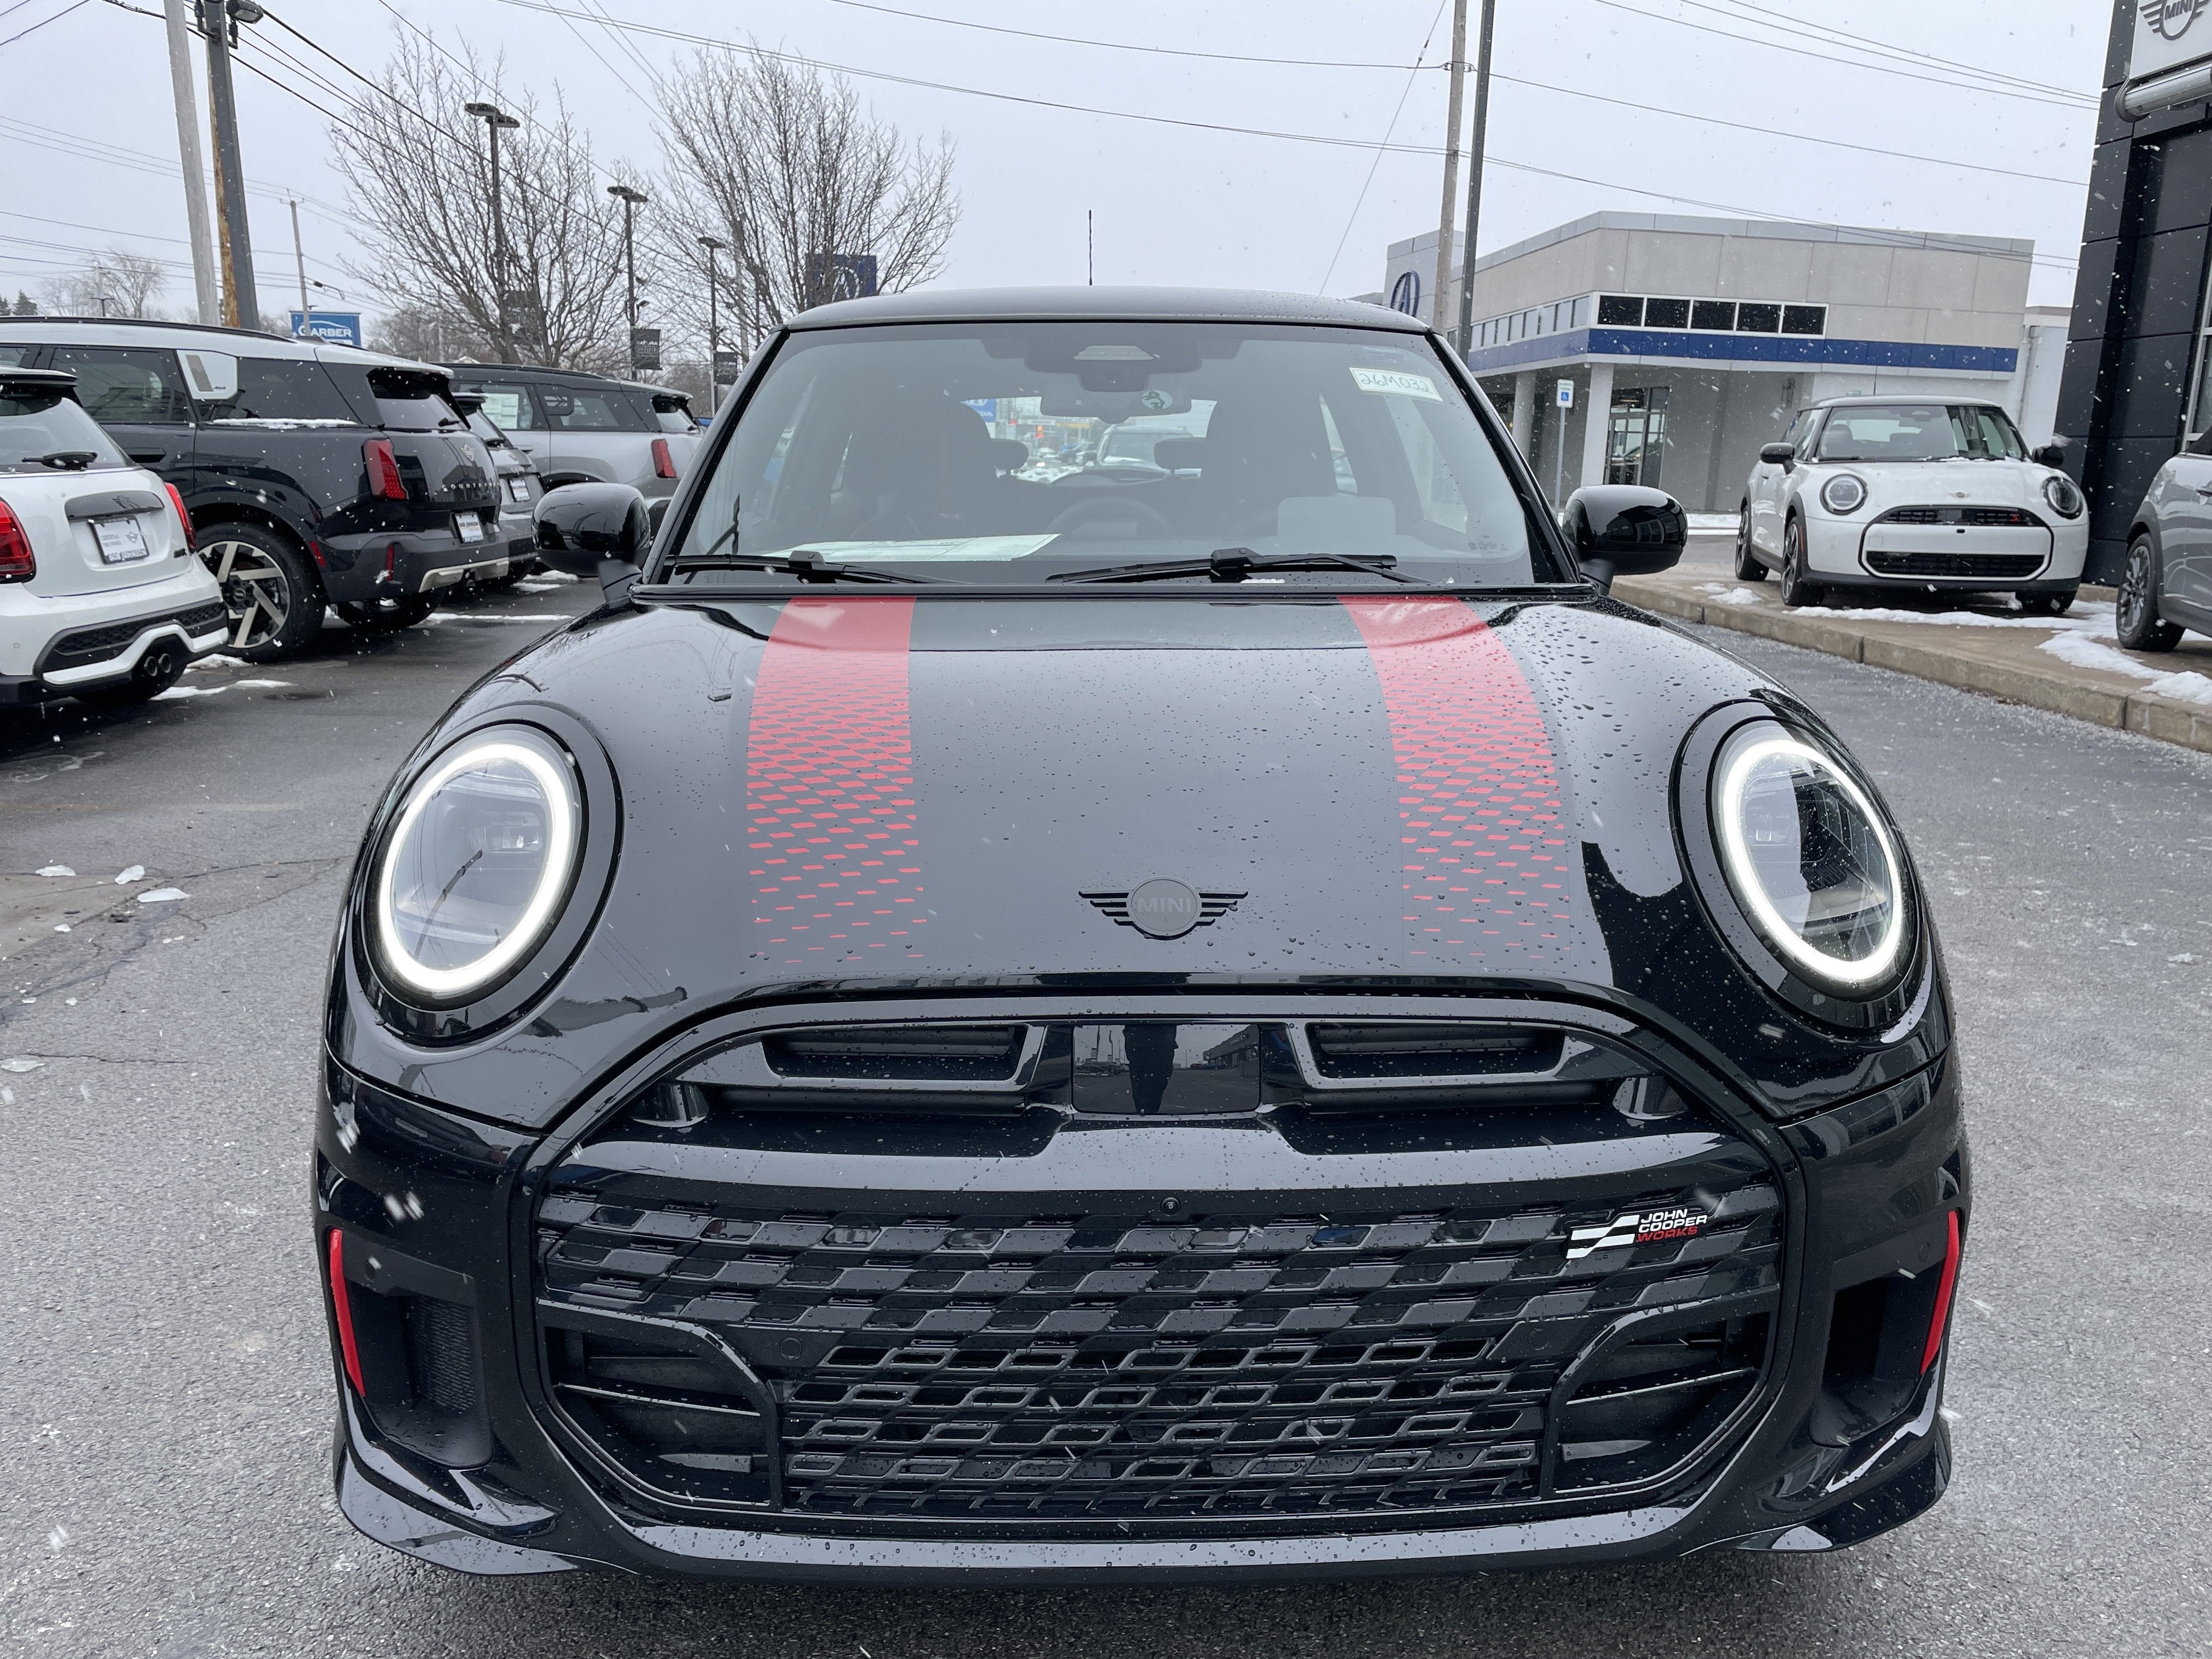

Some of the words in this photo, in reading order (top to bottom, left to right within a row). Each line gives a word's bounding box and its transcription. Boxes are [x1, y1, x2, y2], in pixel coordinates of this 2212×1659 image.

[2165, 0, 2192, 20] MINI
[1359, 373, 1433, 394] 26M032
[1138, 898, 1191, 913] MINI
[1639, 1215, 1707, 1233] COOPER
[1641, 1209, 1688, 1223] JOHN
[1637, 1226, 1697, 1242] WORKS
